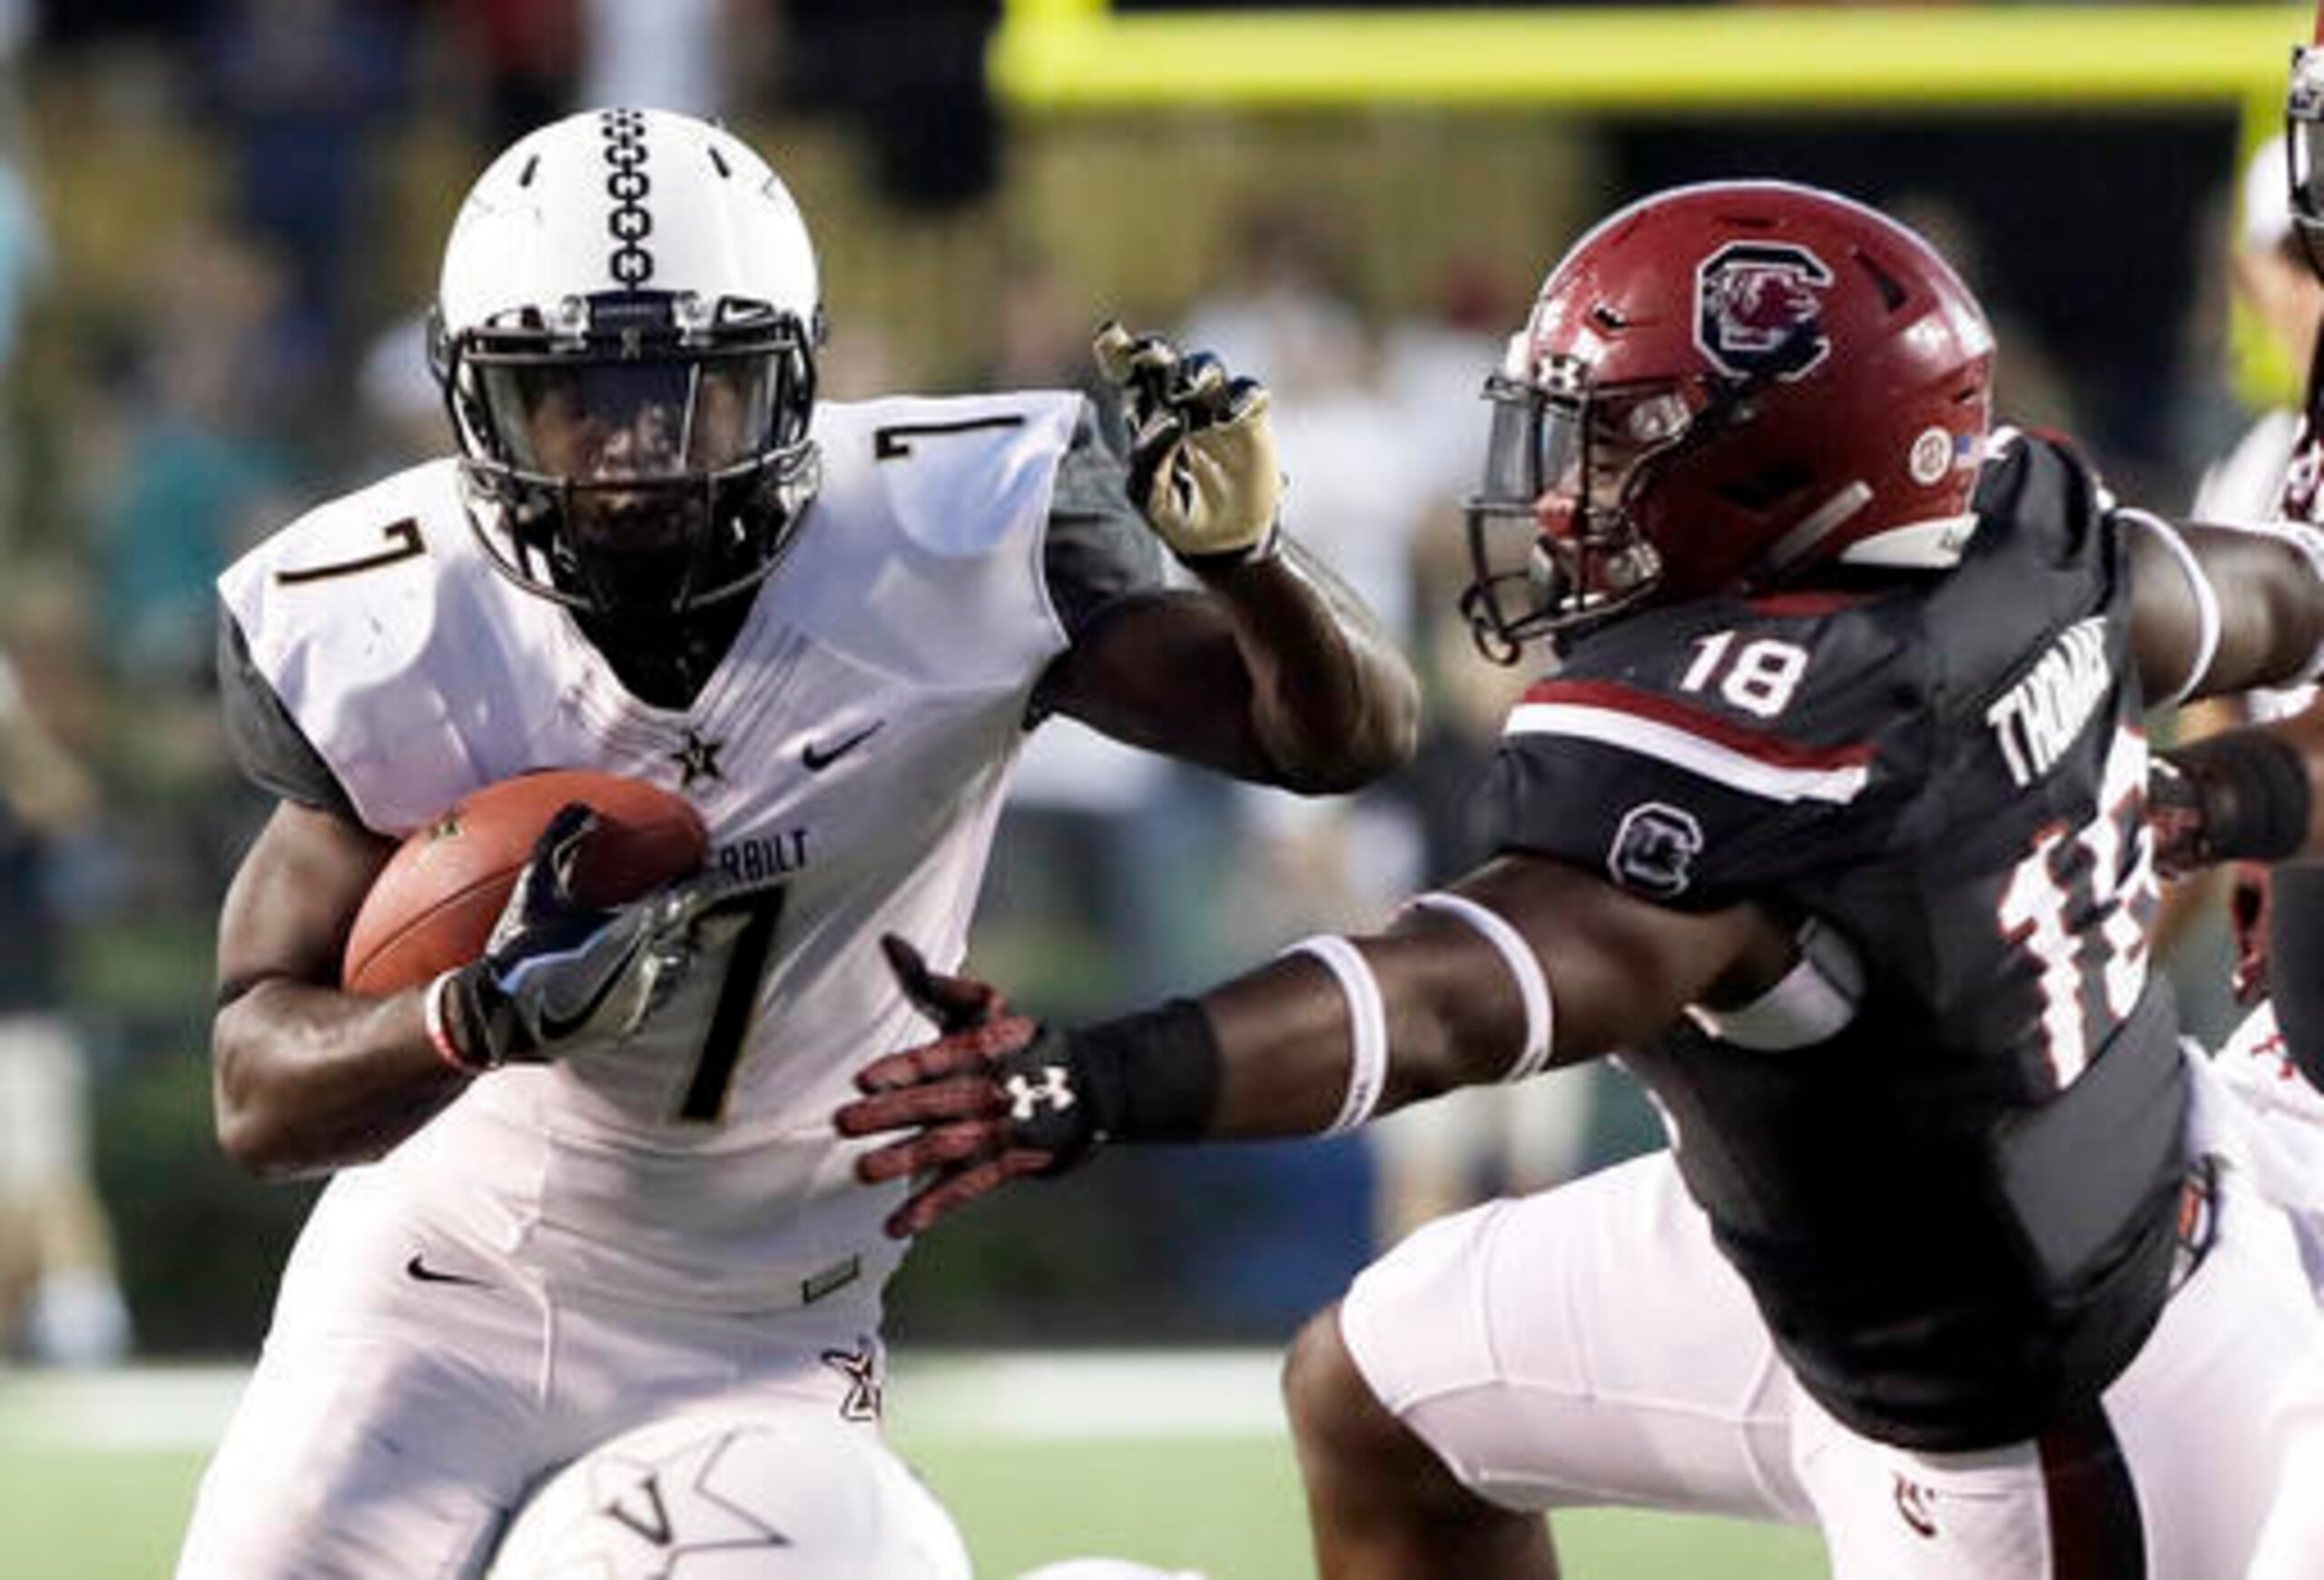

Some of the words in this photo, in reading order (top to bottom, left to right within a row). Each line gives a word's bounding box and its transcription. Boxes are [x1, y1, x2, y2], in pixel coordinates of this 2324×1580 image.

[874, 414, 1025, 460] 7
[275, 517, 426, 586] 7
[1679, 629, 1809, 718] 18
[719, 828, 810, 884] RBILT
[672, 881, 788, 1126] 7
[601, 1473, 673, 1546] V
